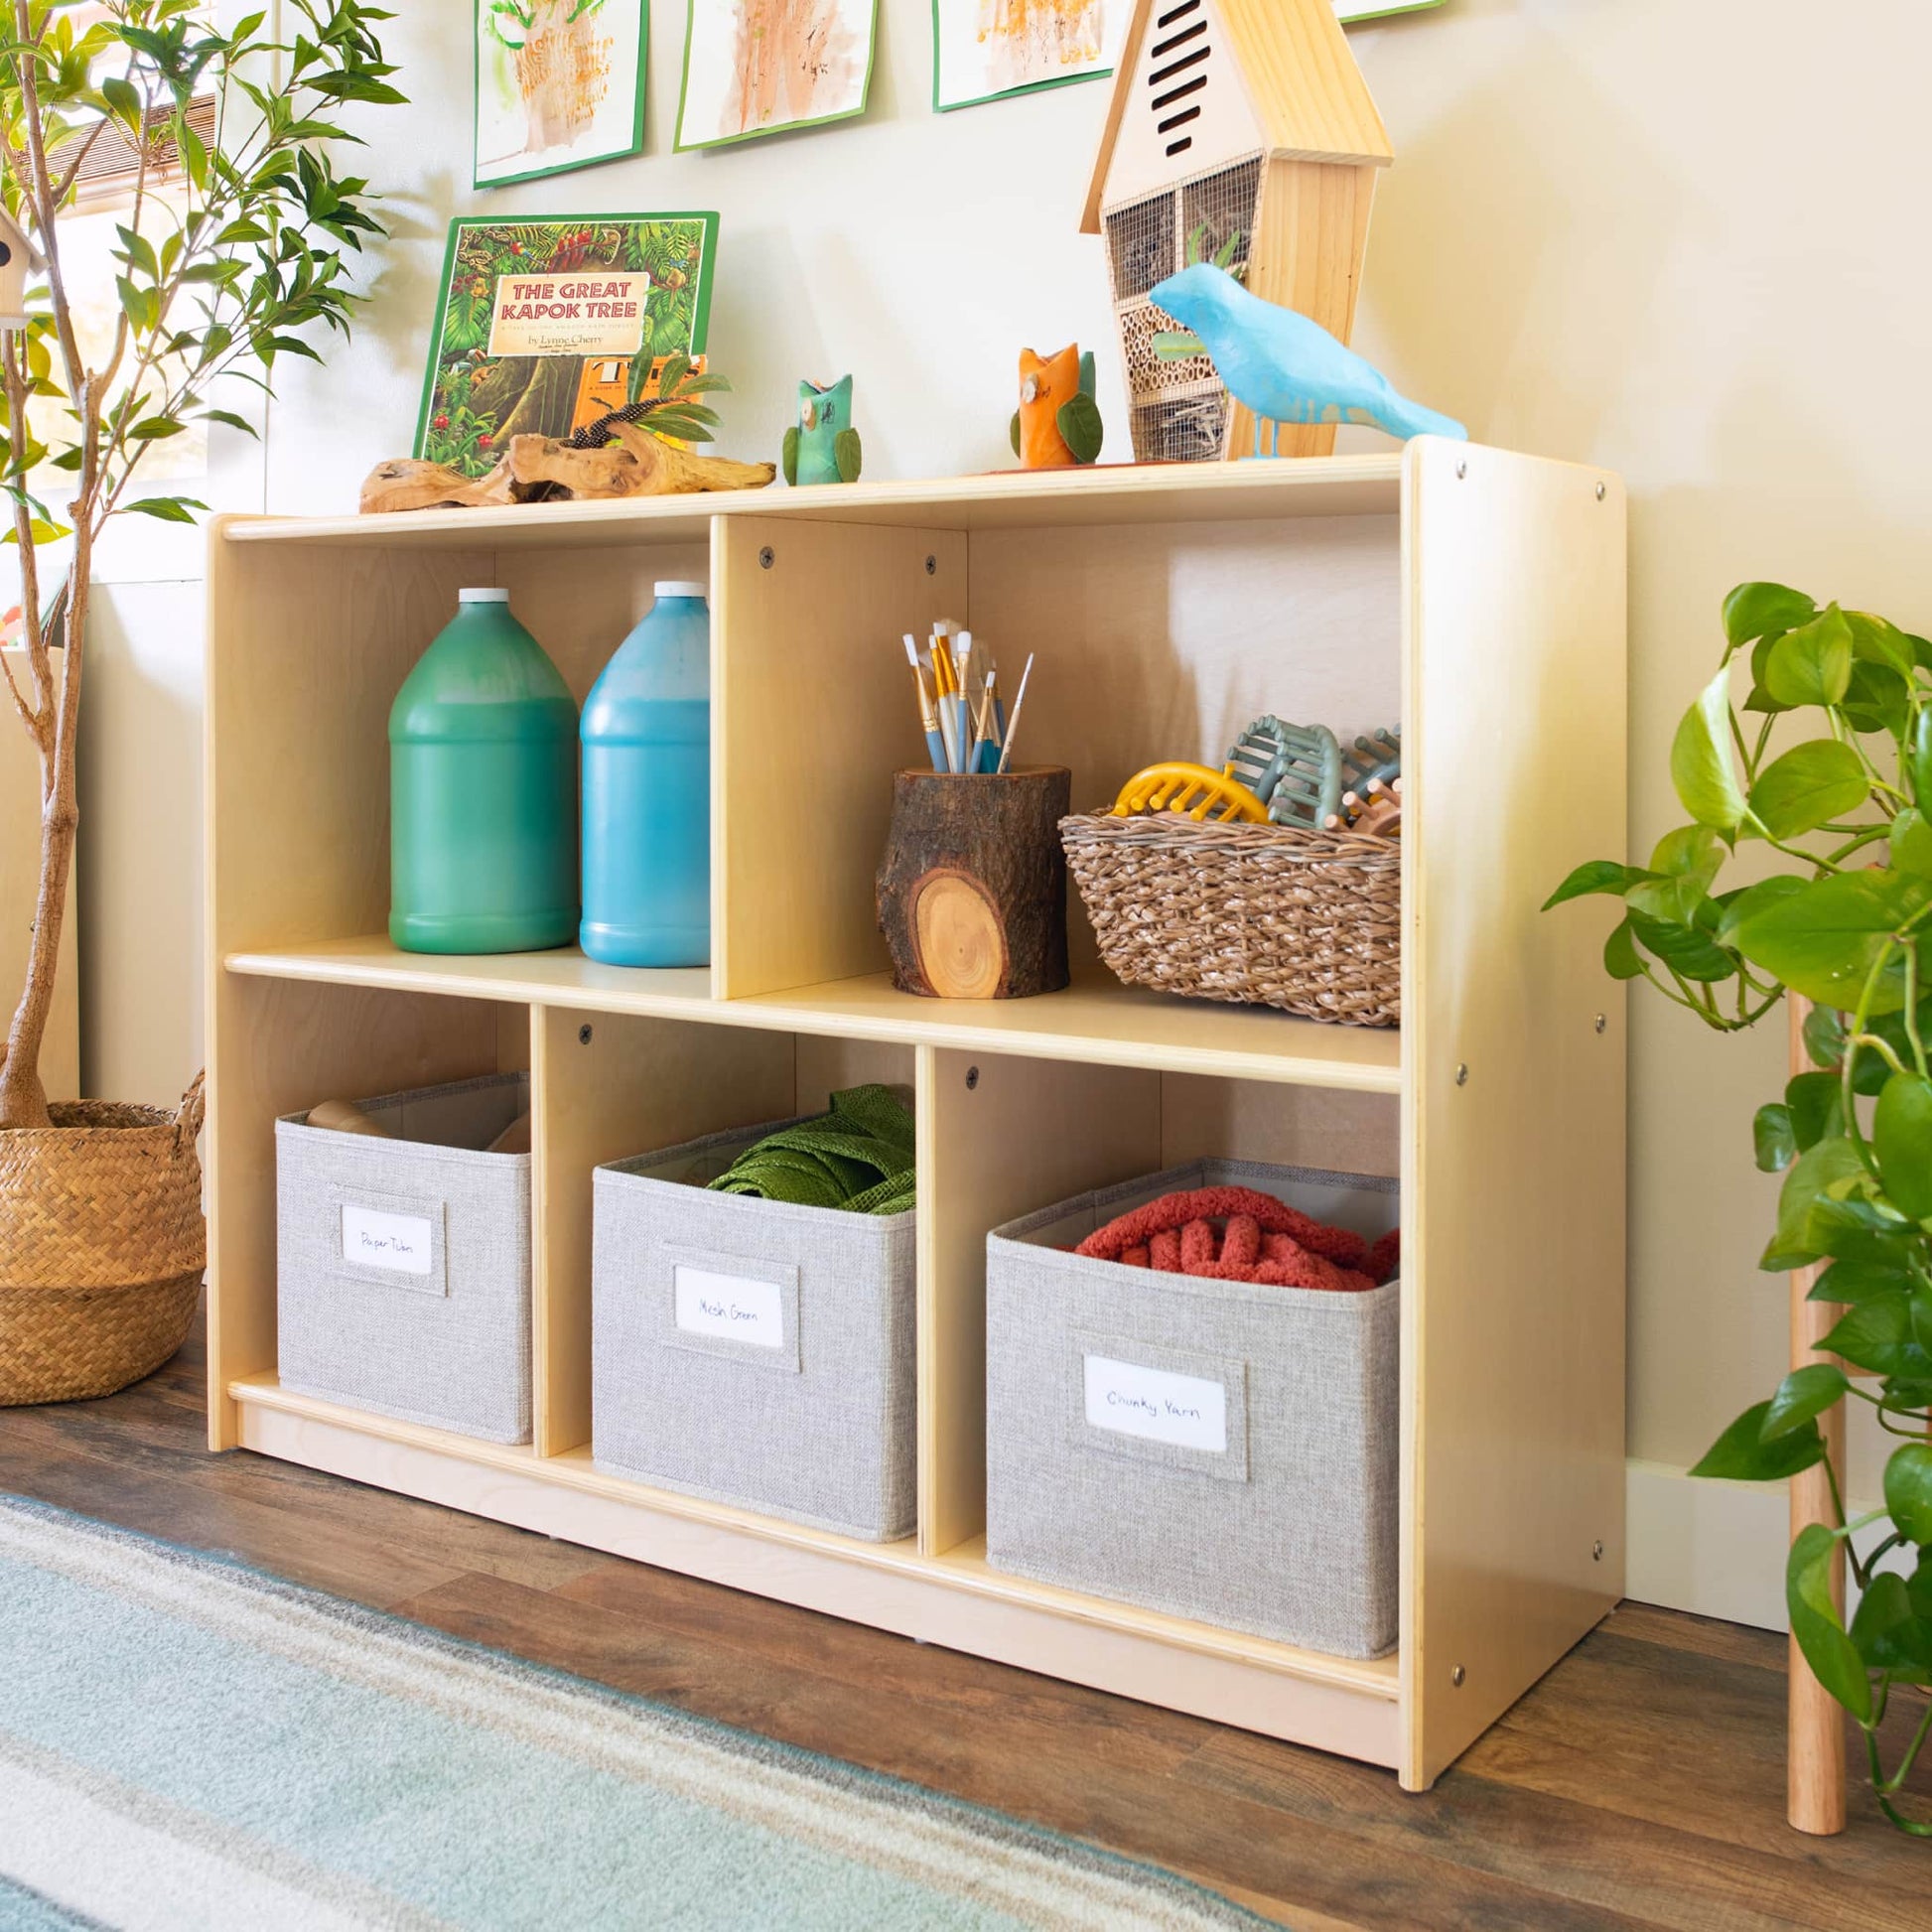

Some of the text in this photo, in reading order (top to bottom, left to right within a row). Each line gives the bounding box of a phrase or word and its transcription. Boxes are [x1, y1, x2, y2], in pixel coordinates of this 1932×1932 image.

[512, 282, 632, 300] THE GREAT
[501, 302, 637, 320] KAPOK TREE
[527, 336, 540, 345] by
[540, 335, 570, 345] Lynne
[571, 334, 605, 345] Cherry
[361, 1231, 388, 1251] Paper
[1106, 1391, 1200, 1420] Chunky Yarn
